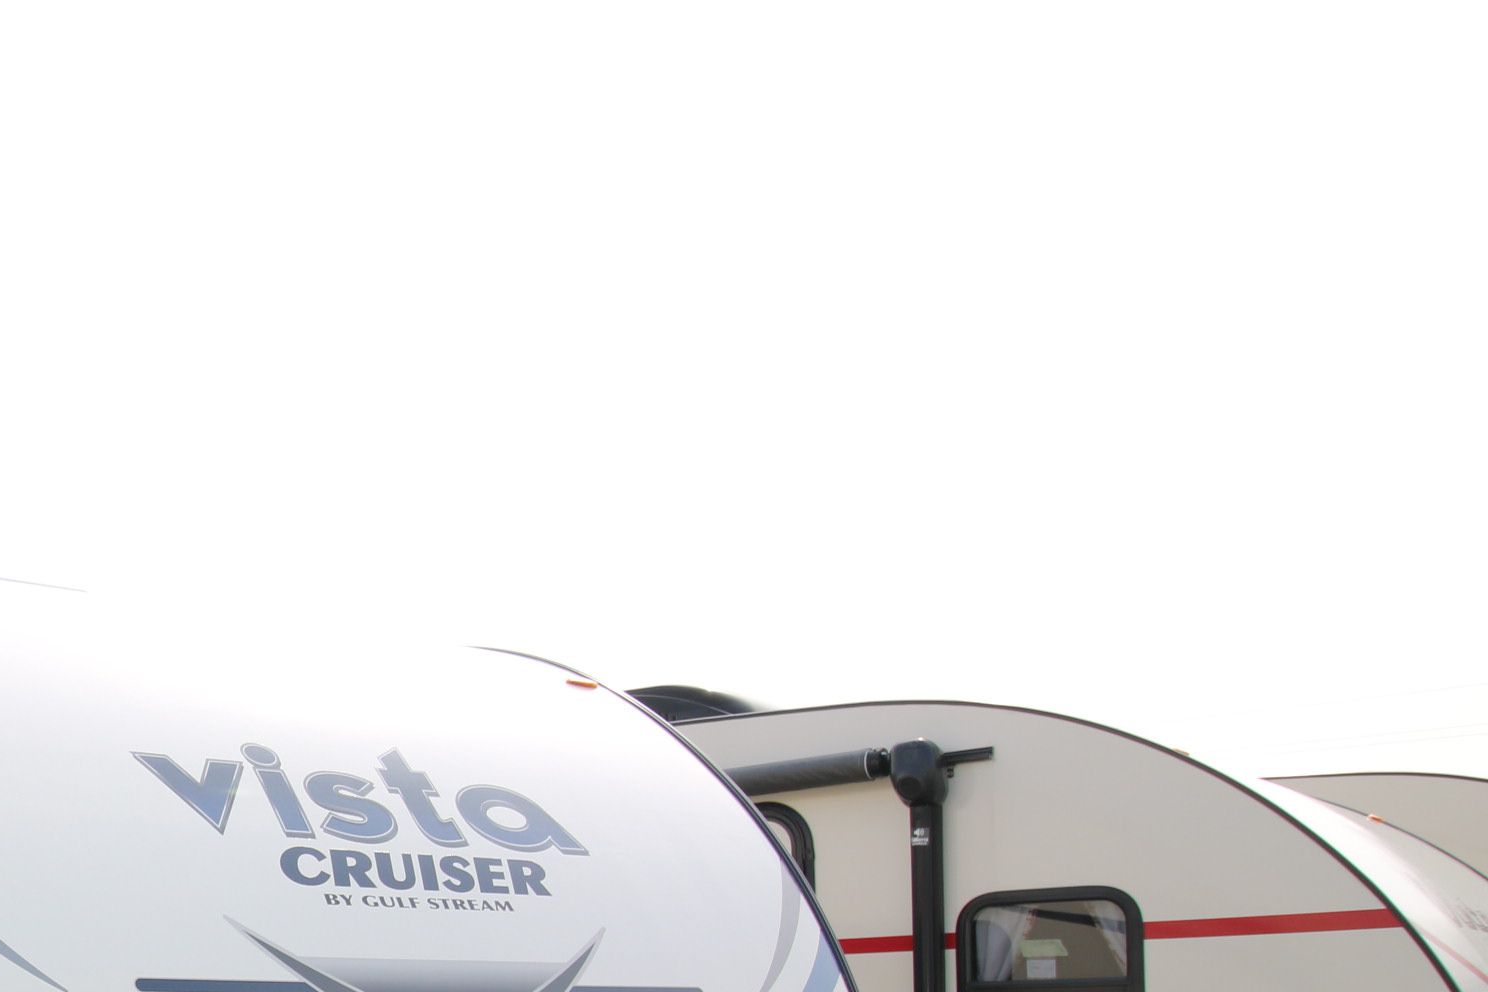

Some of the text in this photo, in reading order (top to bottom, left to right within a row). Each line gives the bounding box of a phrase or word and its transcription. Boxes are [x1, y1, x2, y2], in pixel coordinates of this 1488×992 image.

[130, 742, 590, 857] vista
[279, 846, 552, 897] CRUISER
[324, 893, 515, 912] BY GULF STREAM
